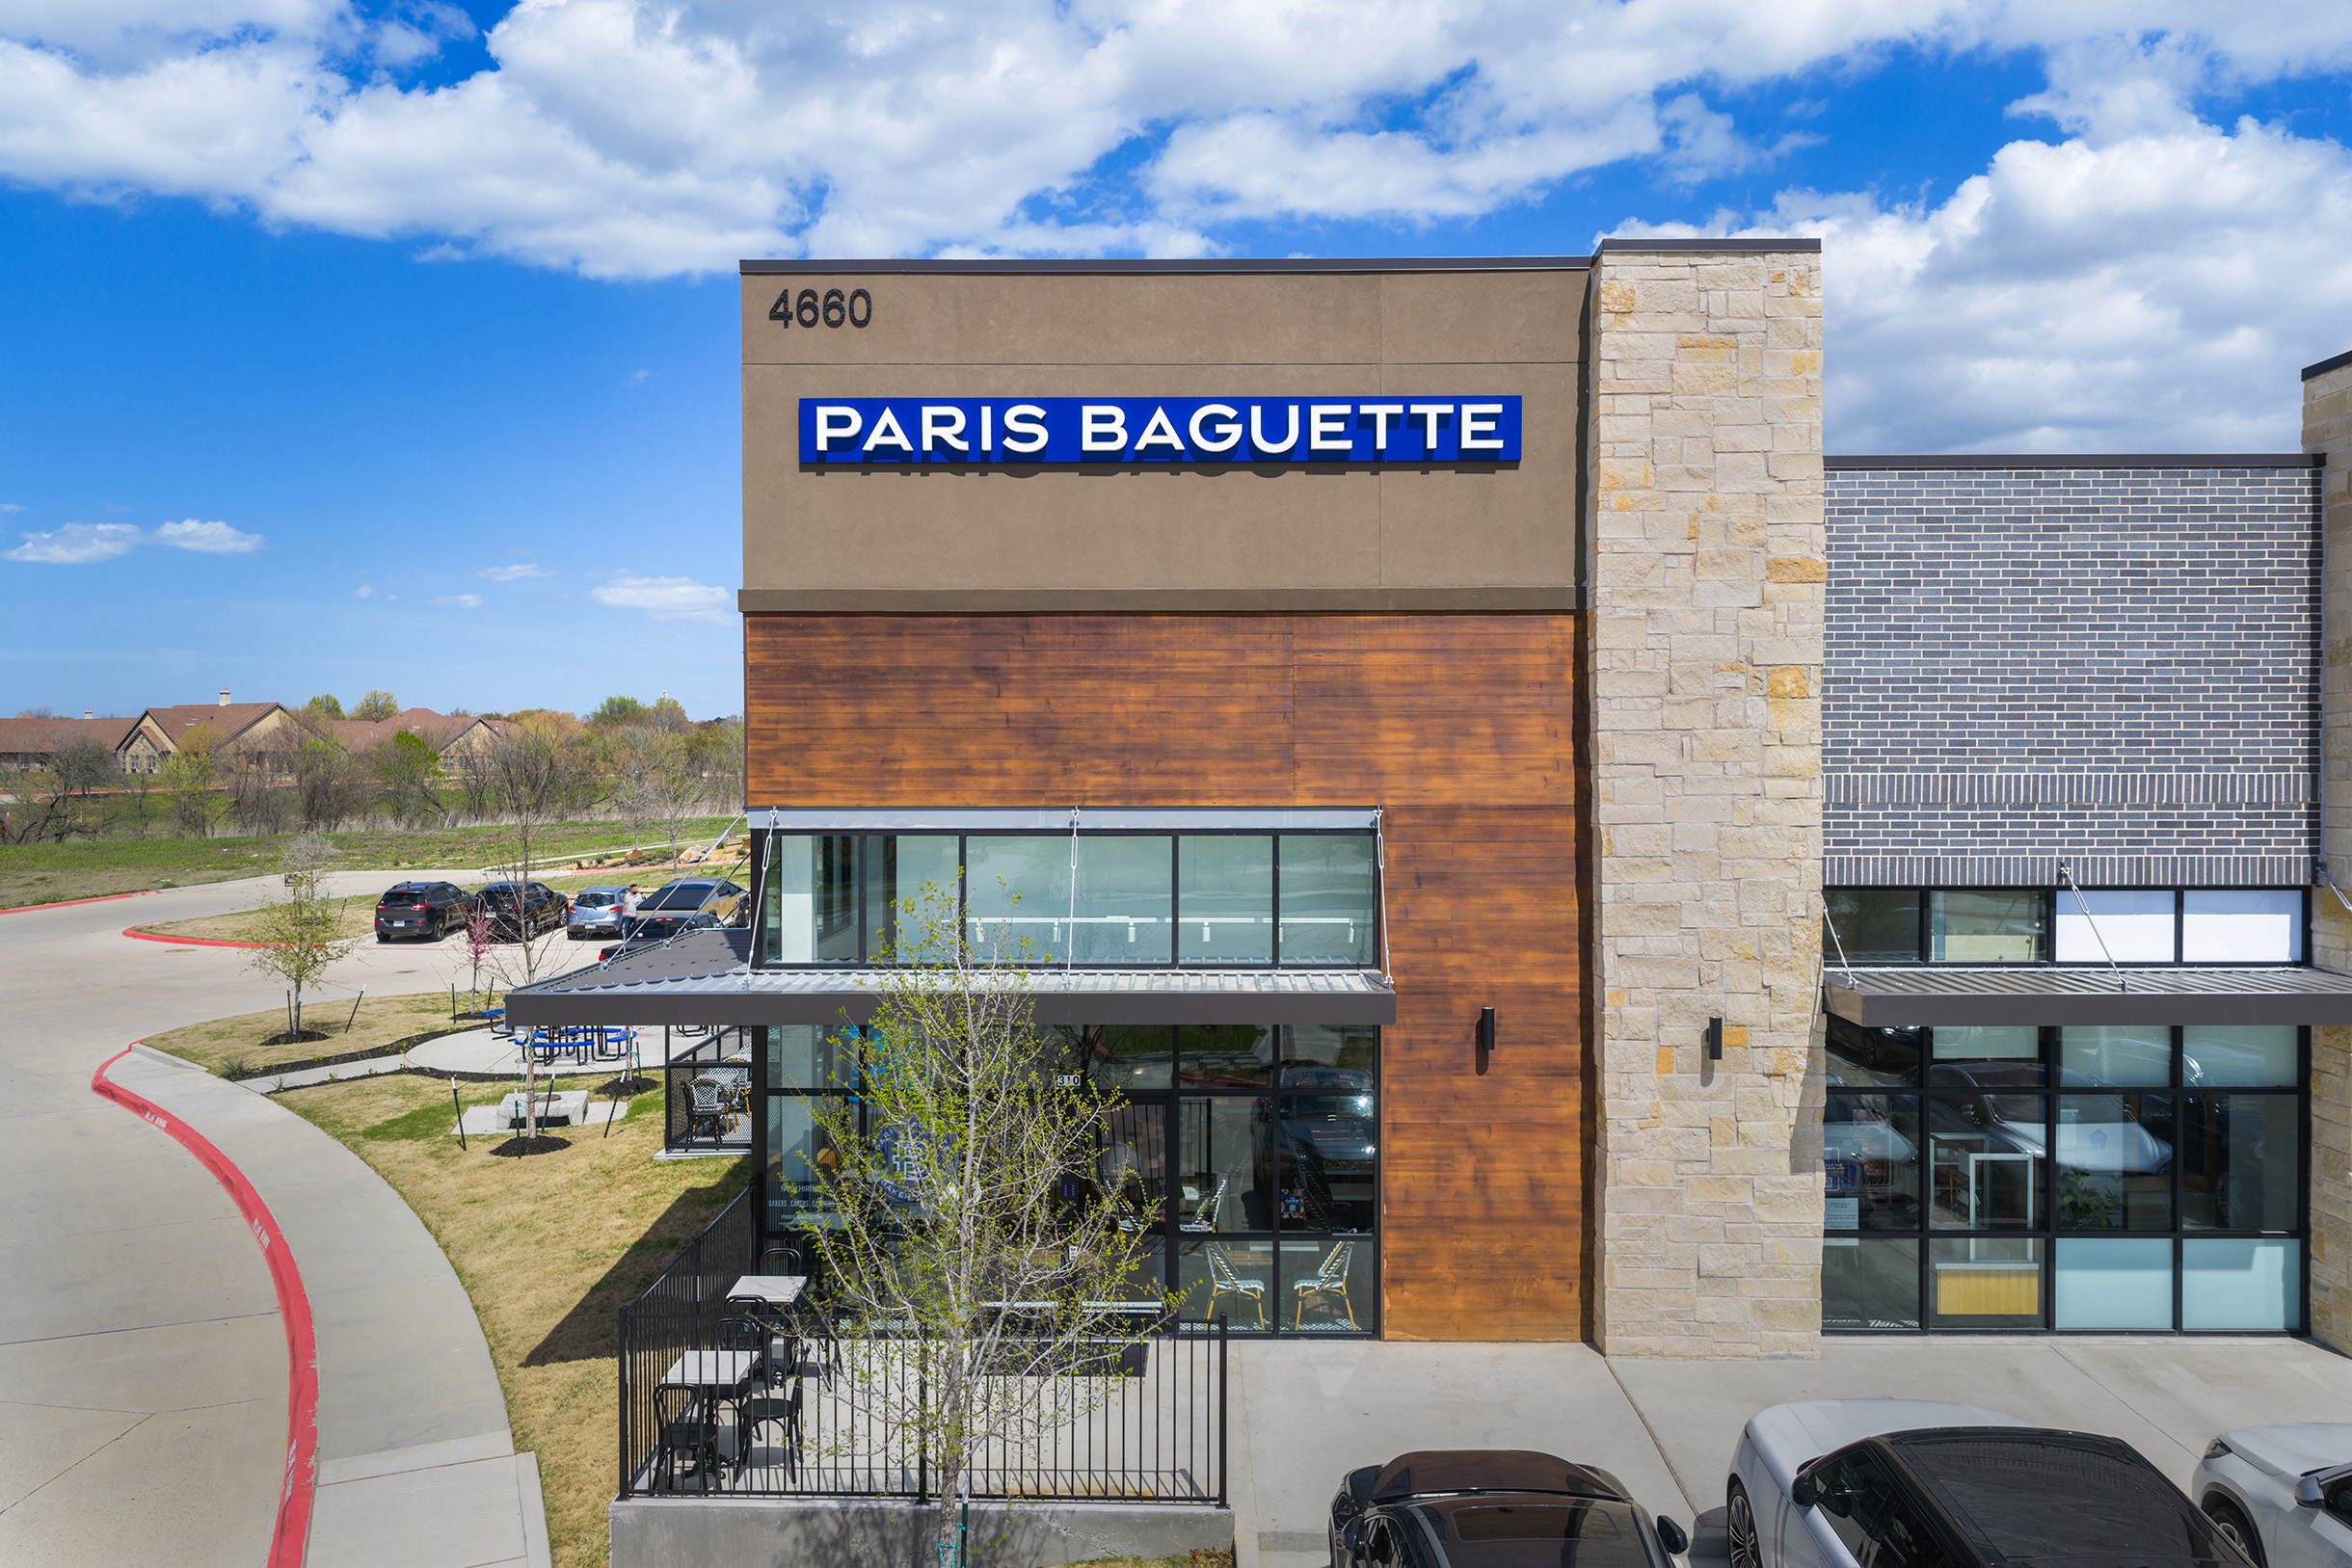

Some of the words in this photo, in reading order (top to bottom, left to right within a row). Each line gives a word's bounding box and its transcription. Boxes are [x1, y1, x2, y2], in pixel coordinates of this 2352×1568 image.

[768, 288, 871, 329] 4660
[815, 405, 1049, 453] PARIS
[1082, 404, 1504, 453] BAGUETTE
[1058, 1076, 1080, 1085] 310
[798, 1184, 823, 1193] HIRIN
[880, 1180, 918, 1202] BAKER
[768, 1199, 788, 1208] BAKERS
